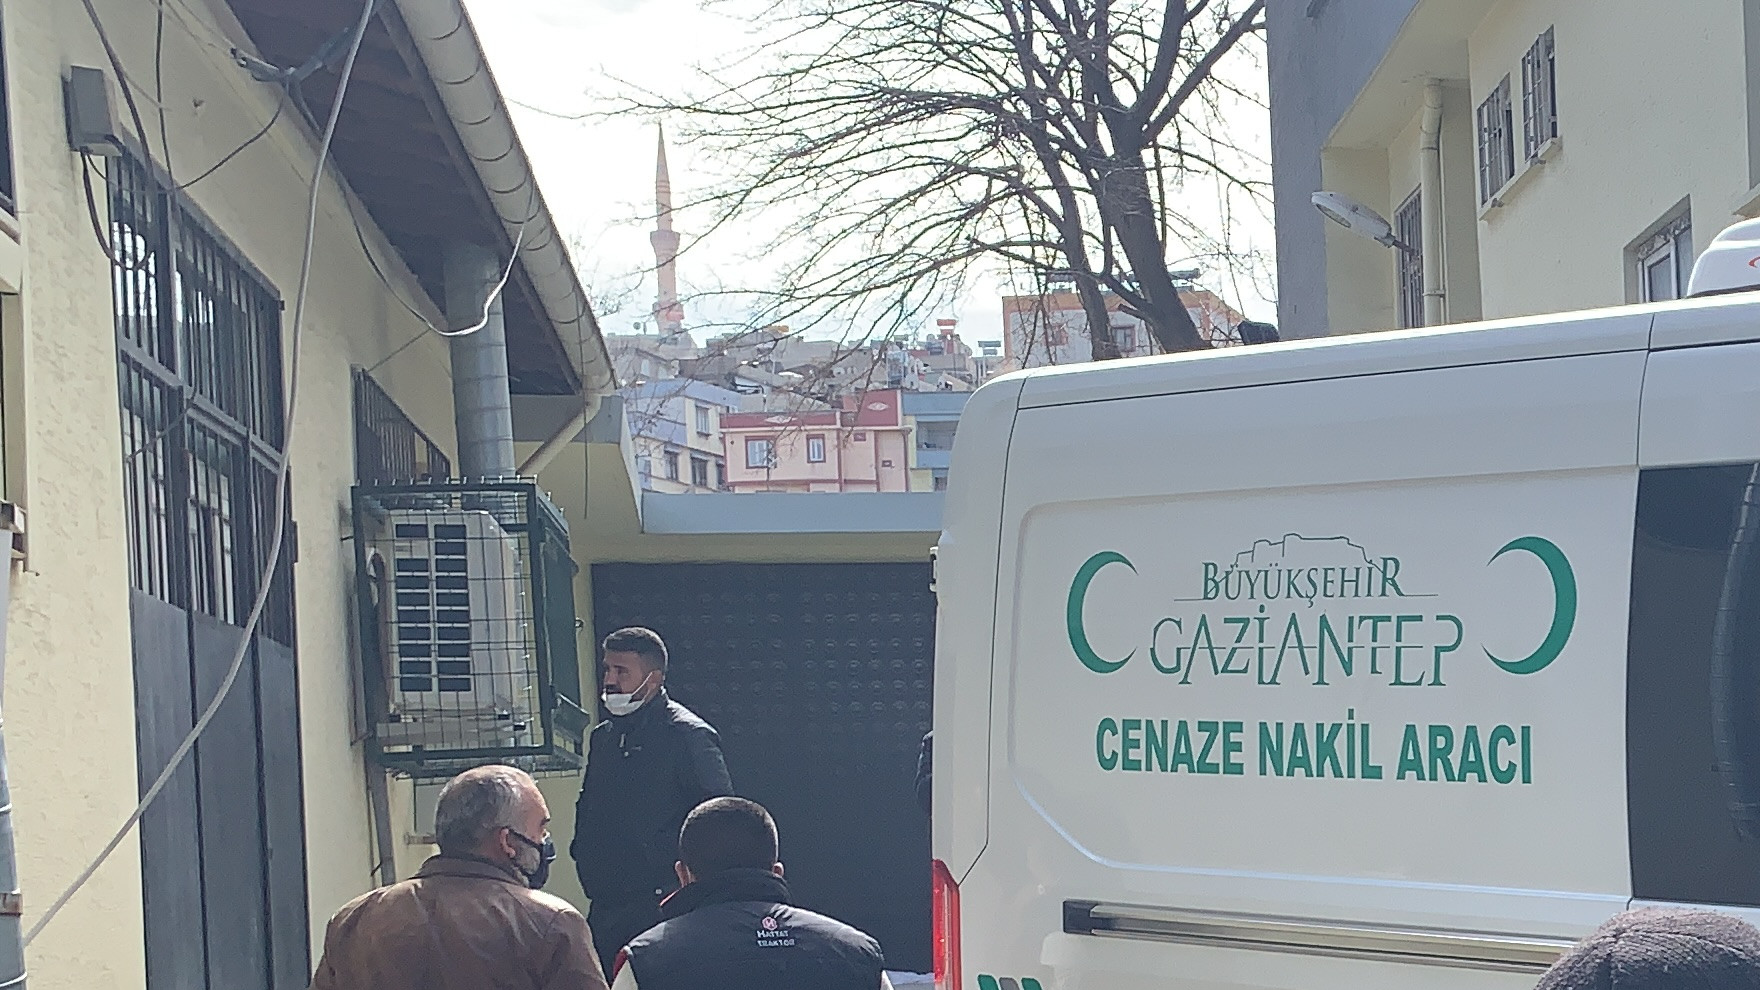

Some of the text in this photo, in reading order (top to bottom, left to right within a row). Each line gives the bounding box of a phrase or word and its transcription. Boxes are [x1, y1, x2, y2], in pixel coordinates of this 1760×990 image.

[1202, 556, 1405, 608] BÜYÜKŞEHİR
[1150, 605, 1463, 687] GAZİANTEP
[1096, 708, 1532, 785] CENAZE NAKİL ARACI
